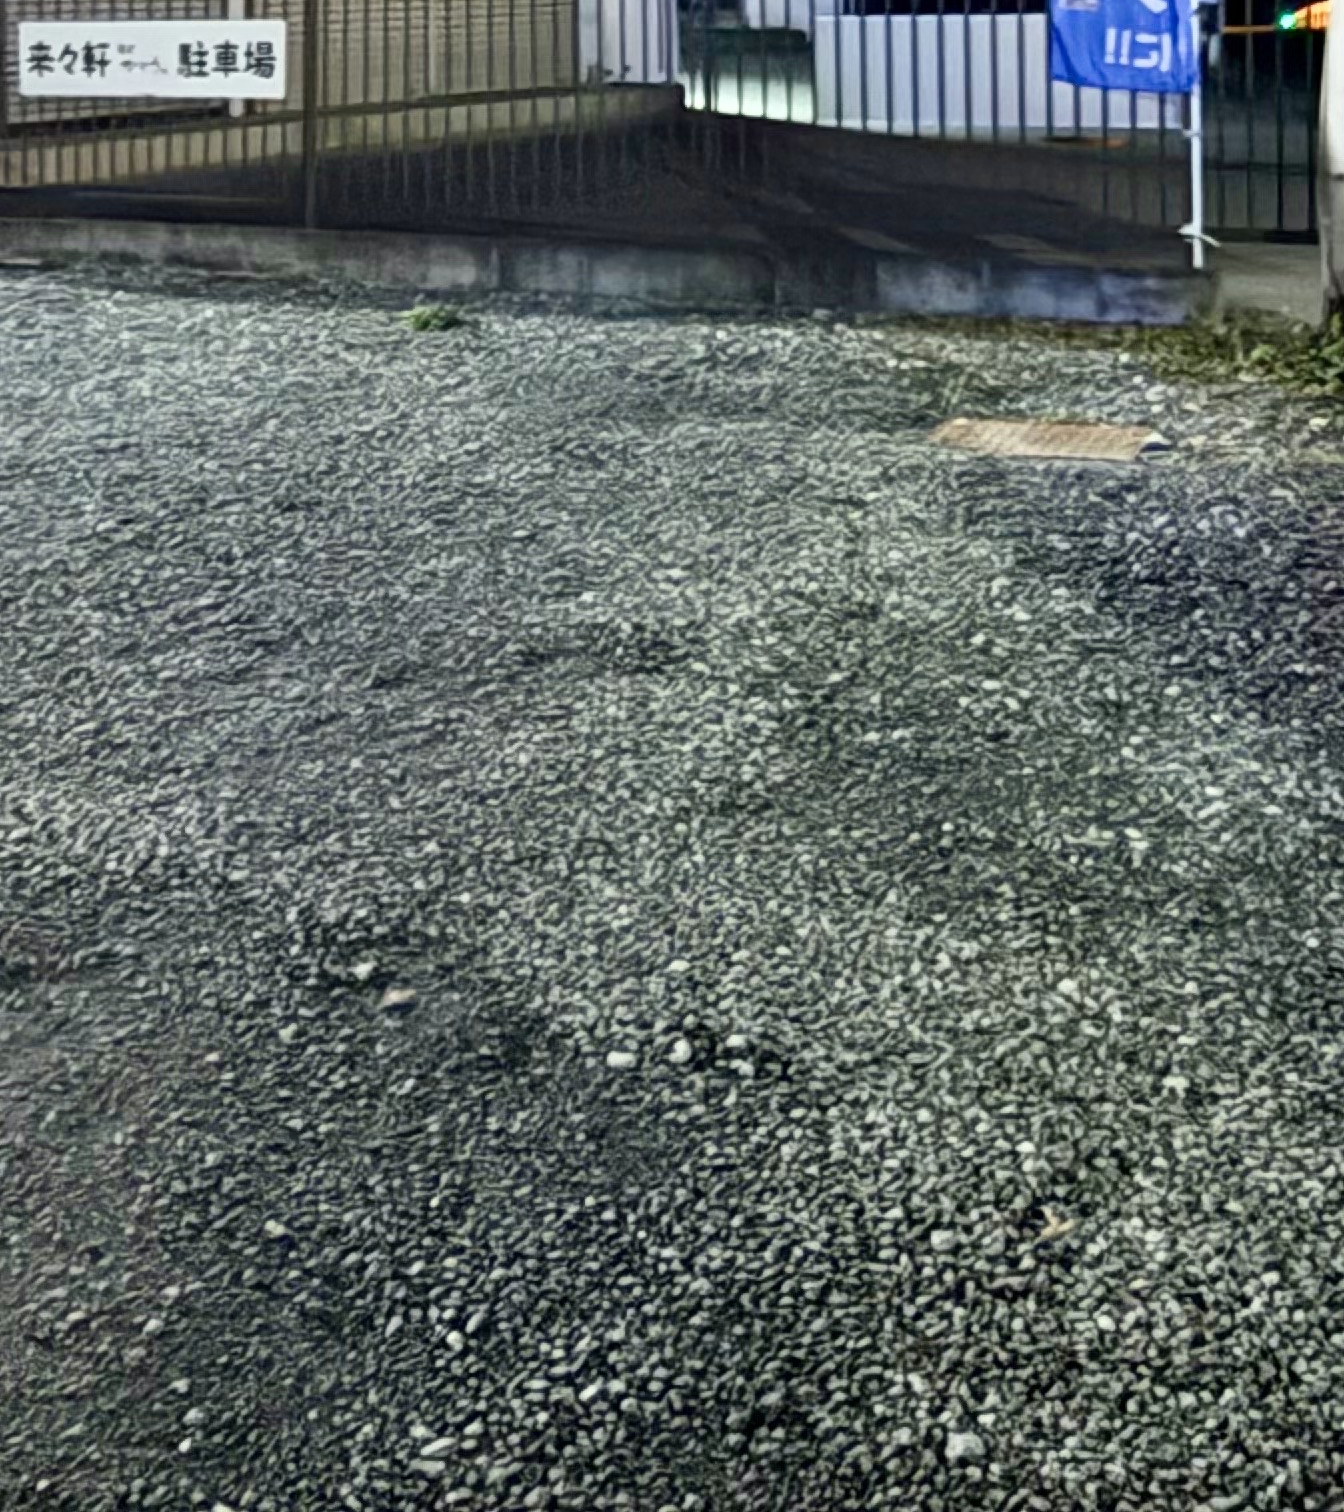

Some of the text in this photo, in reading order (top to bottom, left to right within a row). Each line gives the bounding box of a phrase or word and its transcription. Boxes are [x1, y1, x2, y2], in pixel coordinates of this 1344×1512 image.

[25, 40, 112, 78] 来々軒
[176, 39, 278, 80] 駐車場
